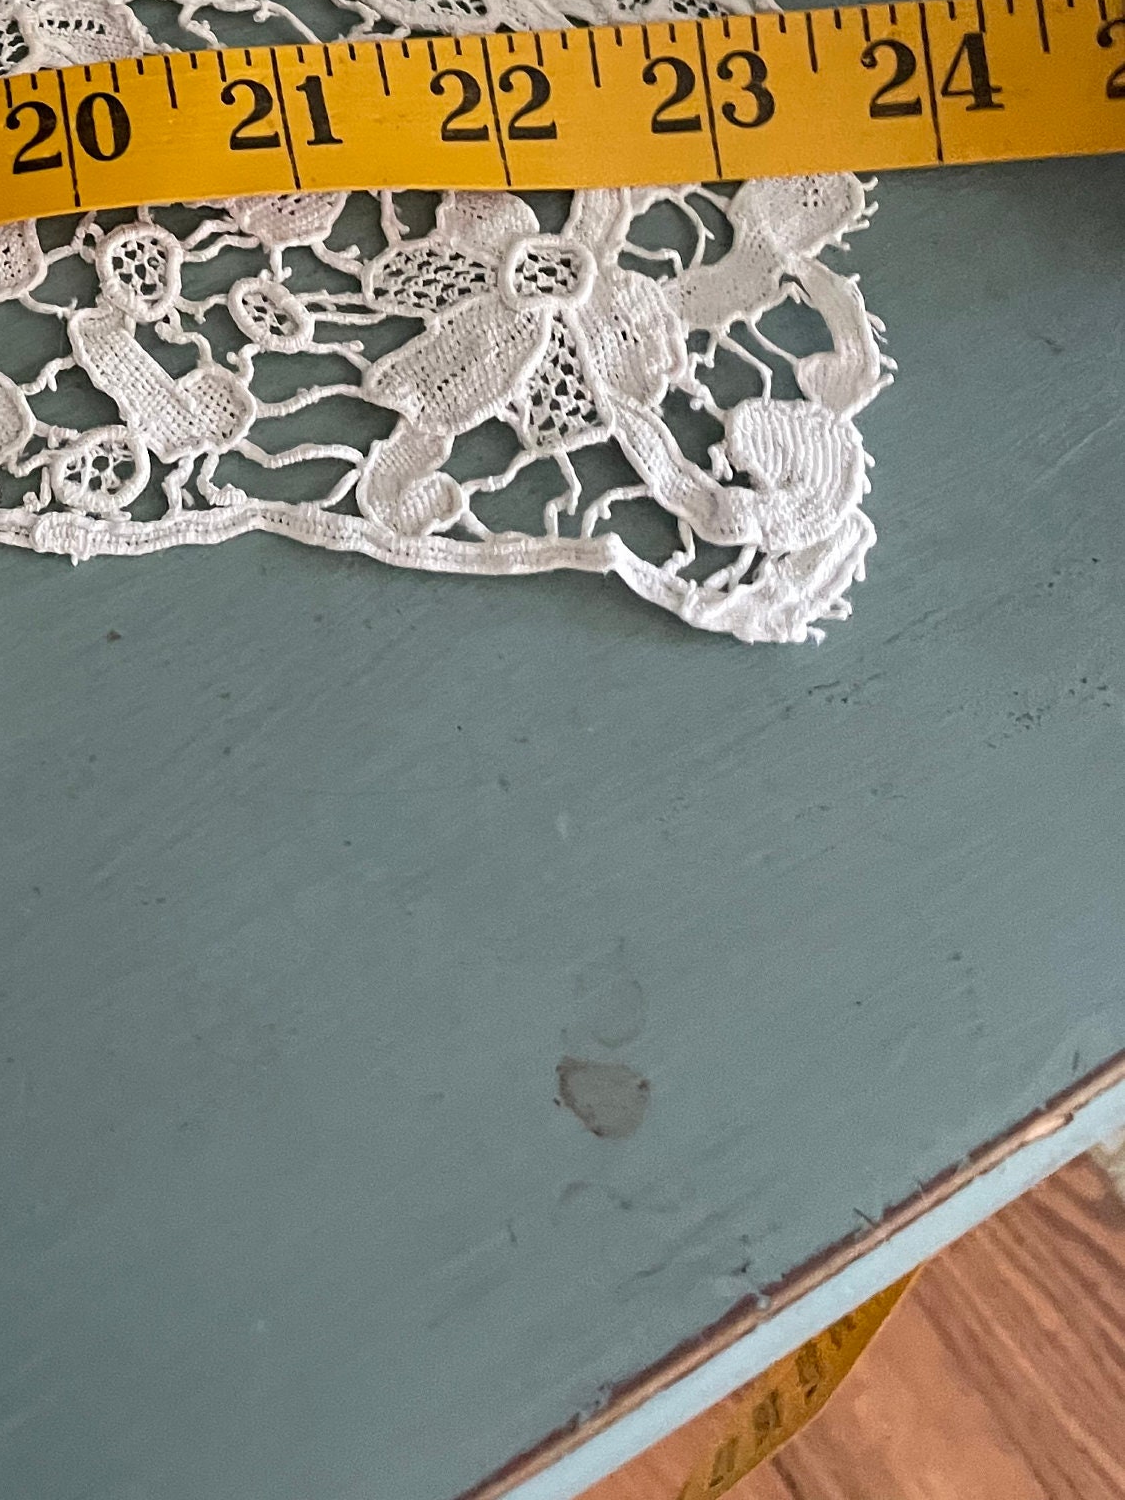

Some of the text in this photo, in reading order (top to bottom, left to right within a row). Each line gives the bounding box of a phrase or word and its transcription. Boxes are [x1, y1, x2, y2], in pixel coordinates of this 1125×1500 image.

[6, 91, 132, 175] 20
[220, 74, 344, 150] 21
[430, 64, 558, 141] 22
[641, 49, 776, 134] 23
[860, 32, 1005, 119] 24
